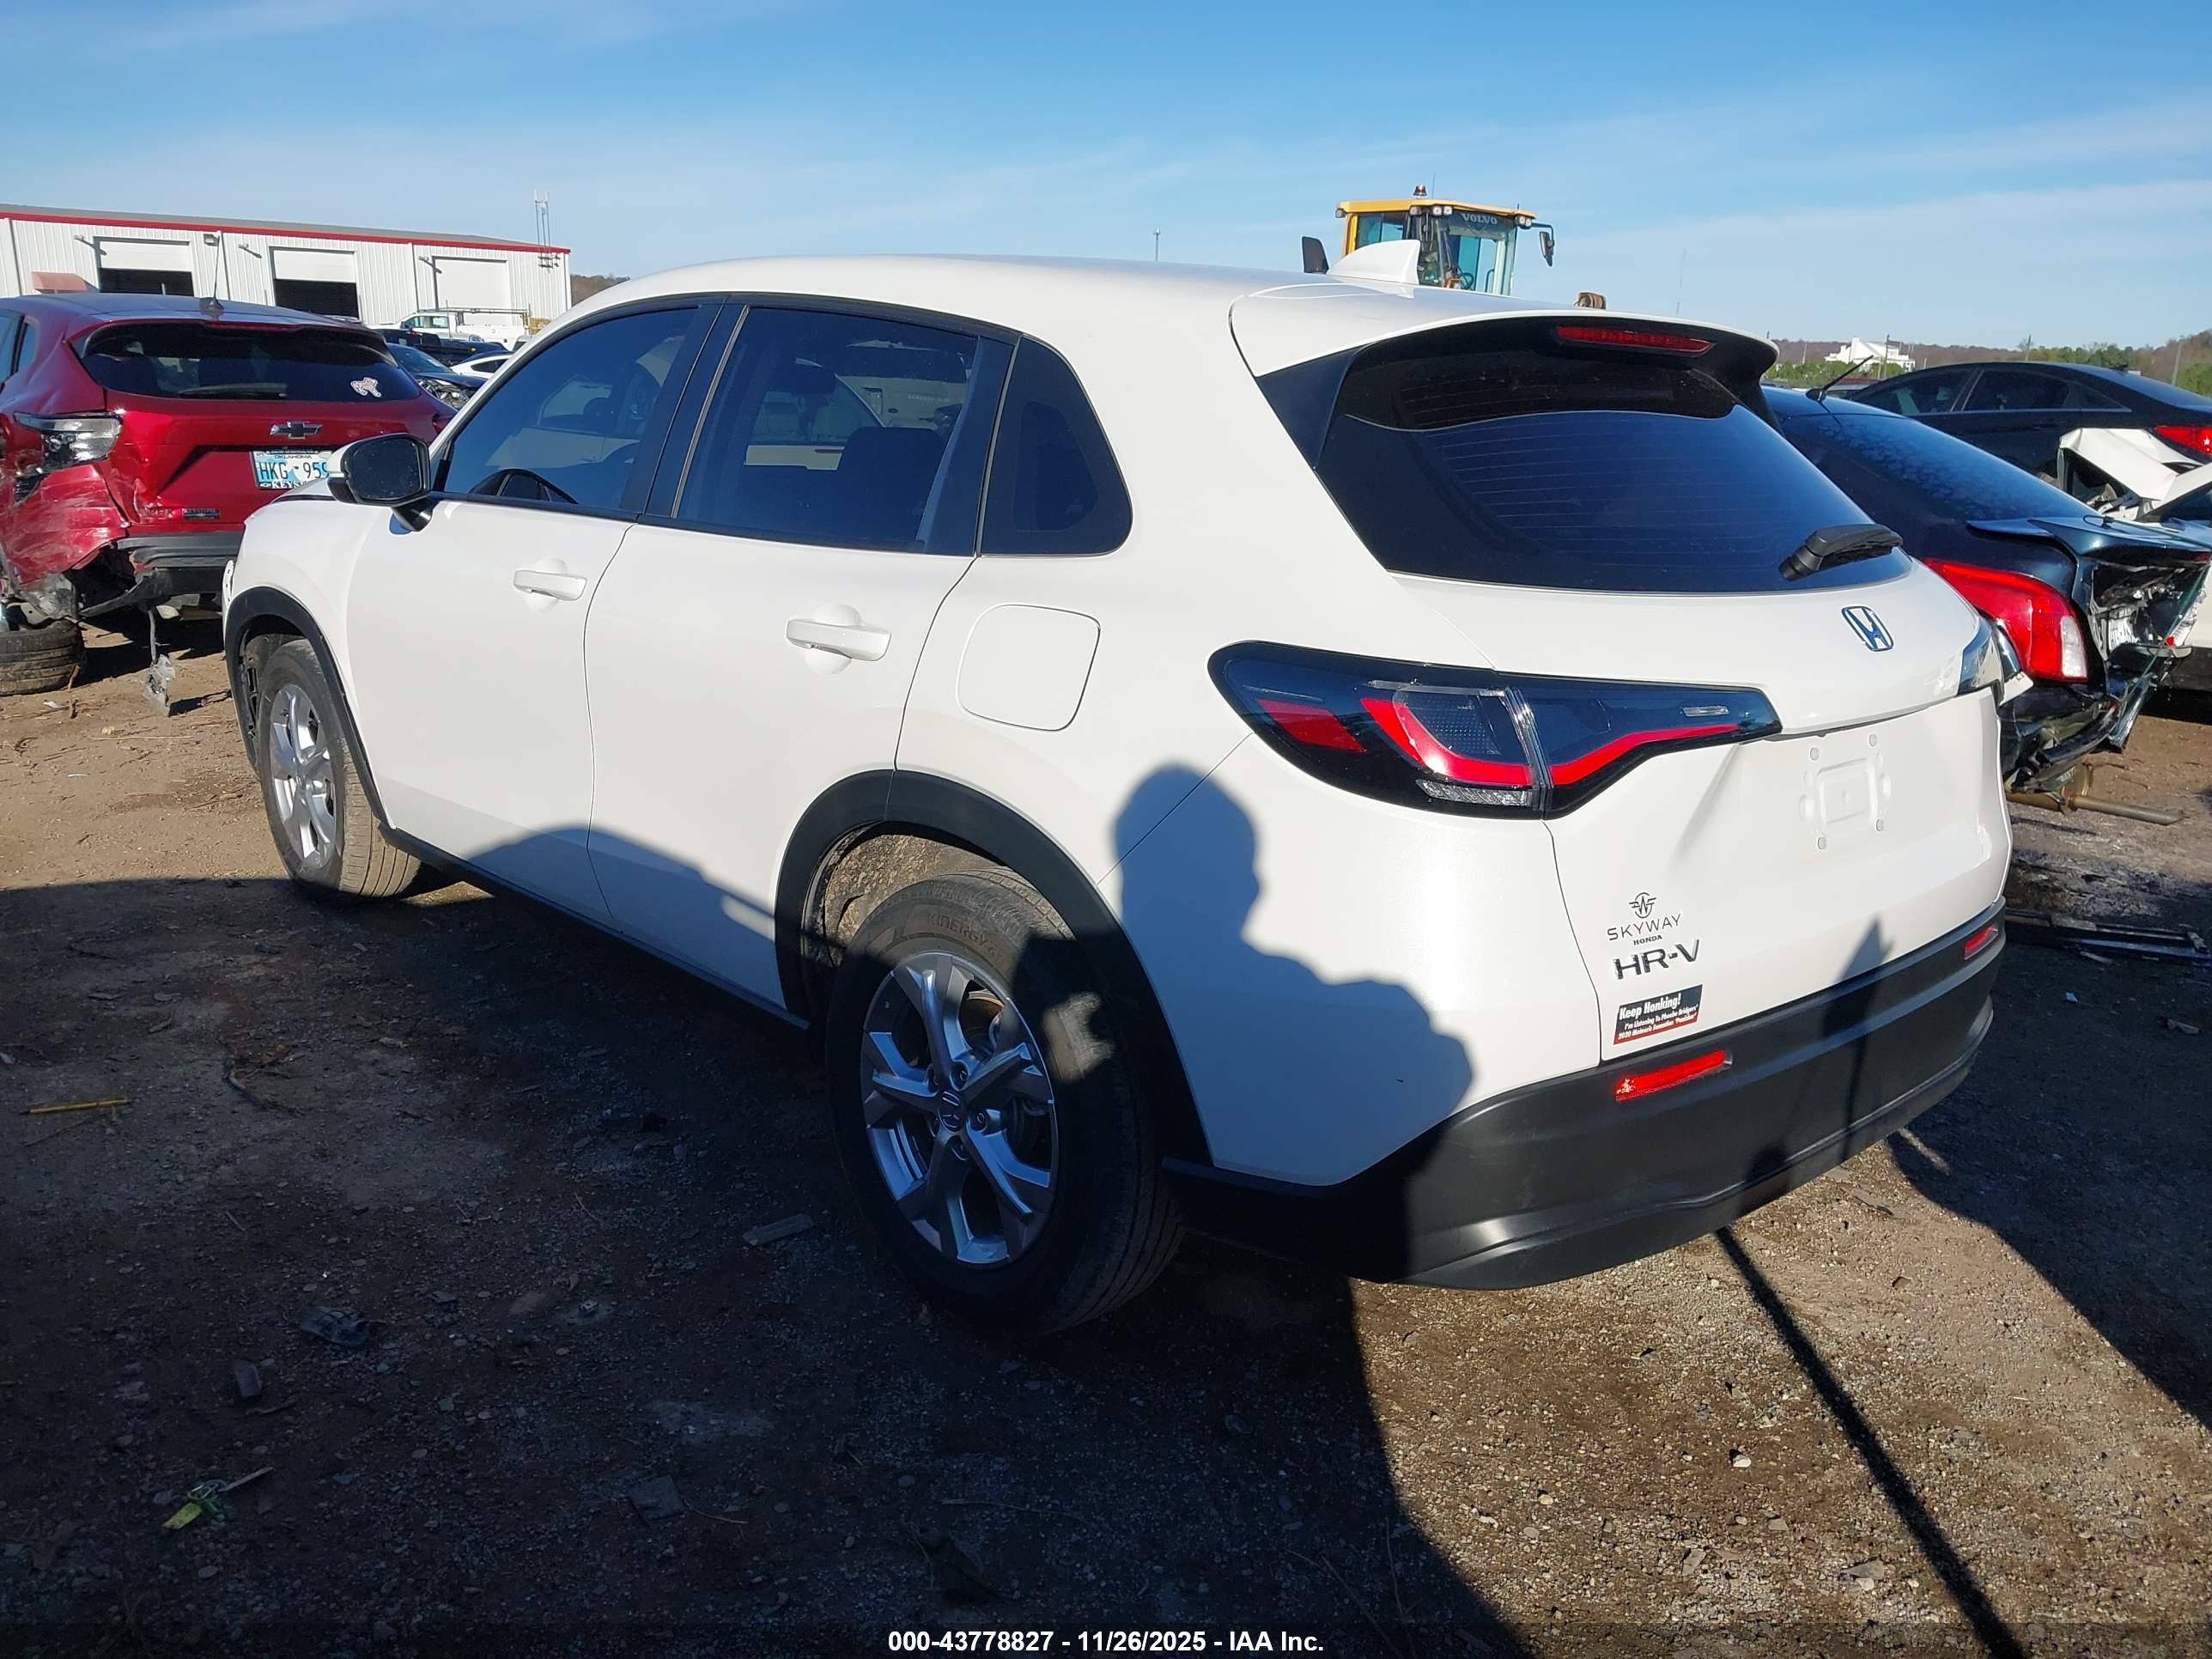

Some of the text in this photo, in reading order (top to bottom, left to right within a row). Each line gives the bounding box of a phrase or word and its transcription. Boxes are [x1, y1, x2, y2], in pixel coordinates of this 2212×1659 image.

[1460, 212, 1498, 225] VOLVO
[258, 461, 289, 480] HKG
[1607, 913, 1681, 941] SKYWAY
[1633, 934, 1663, 945] HONDA
[1613, 939, 1700, 980] HR-V
[1619, 993, 1681, 1020] Keep Honking!
[1634, 1016, 1655, 1028] Listening
